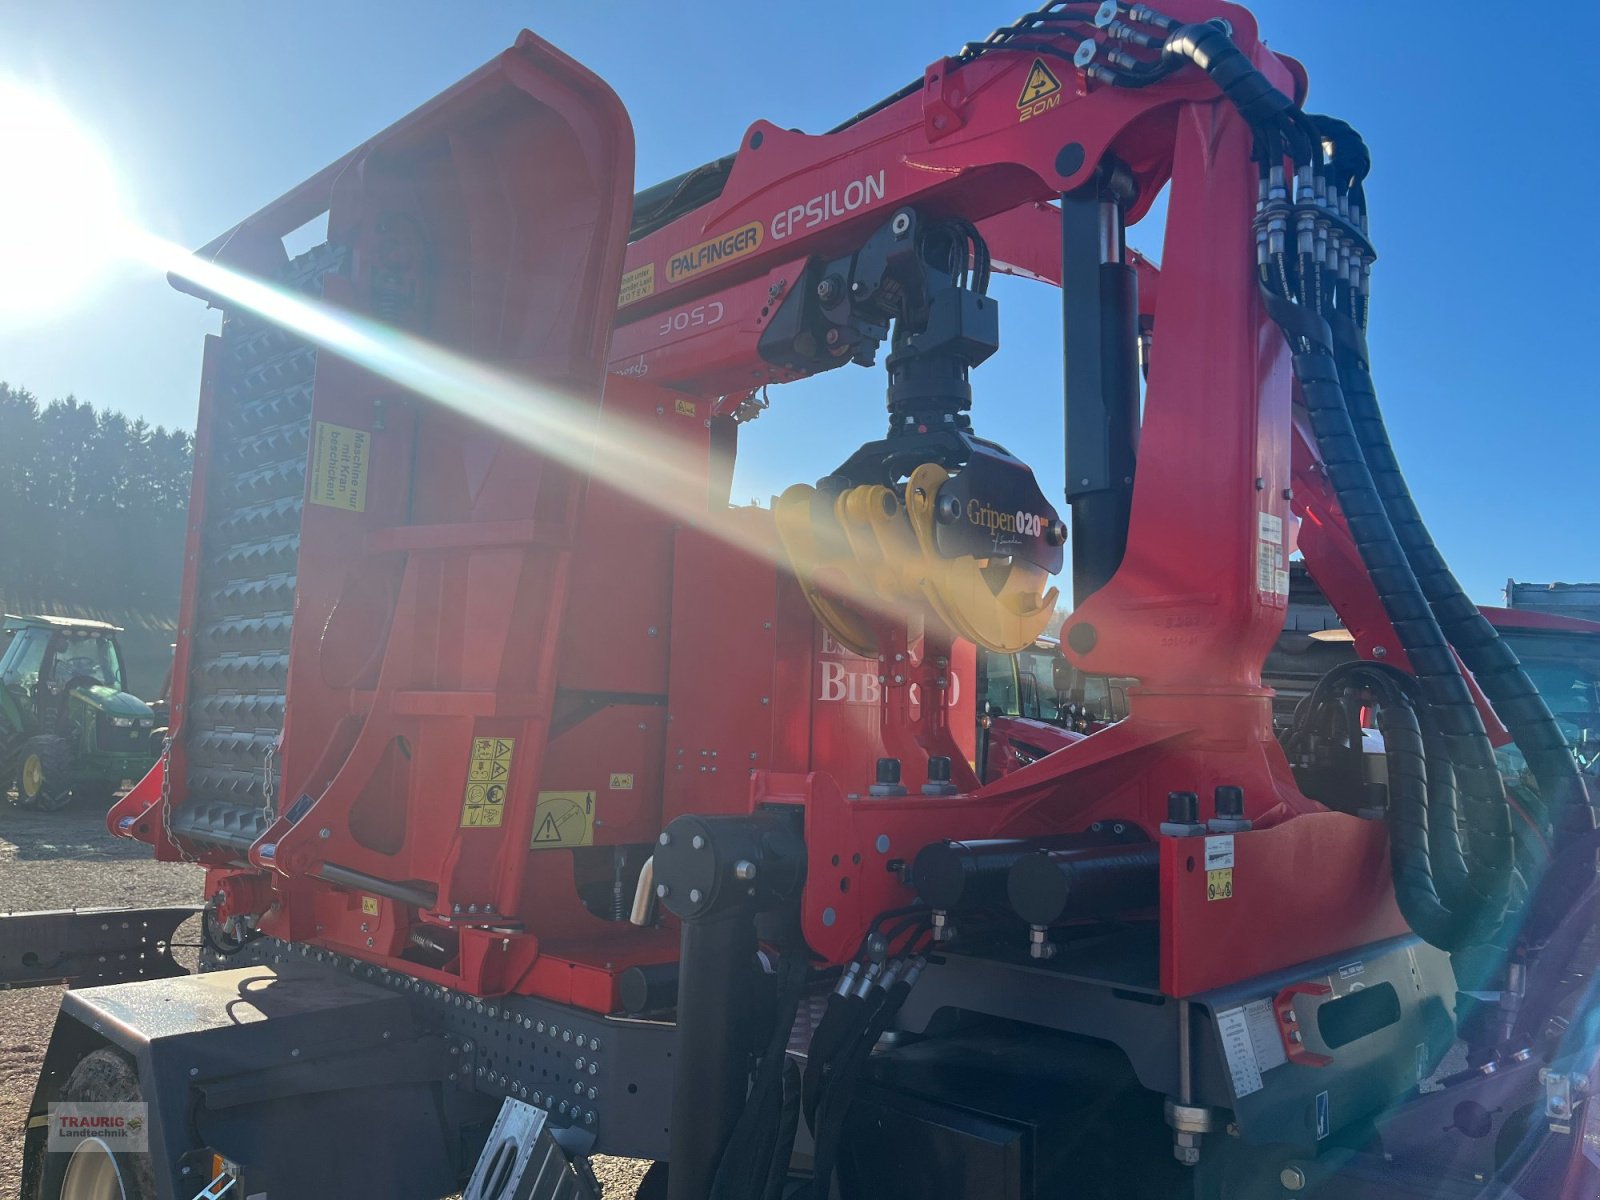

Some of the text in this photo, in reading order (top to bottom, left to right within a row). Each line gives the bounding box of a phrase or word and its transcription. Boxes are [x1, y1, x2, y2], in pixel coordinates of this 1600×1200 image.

[770, 169, 886, 241] EPSILON
[670, 226, 758, 279] PALFINGER
[659, 301, 725, 336] C50F
[326, 431, 341, 501] beschicken!
[338, 444, 351, 492] mit Kran
[349, 432, 365, 509] Maschine nur
